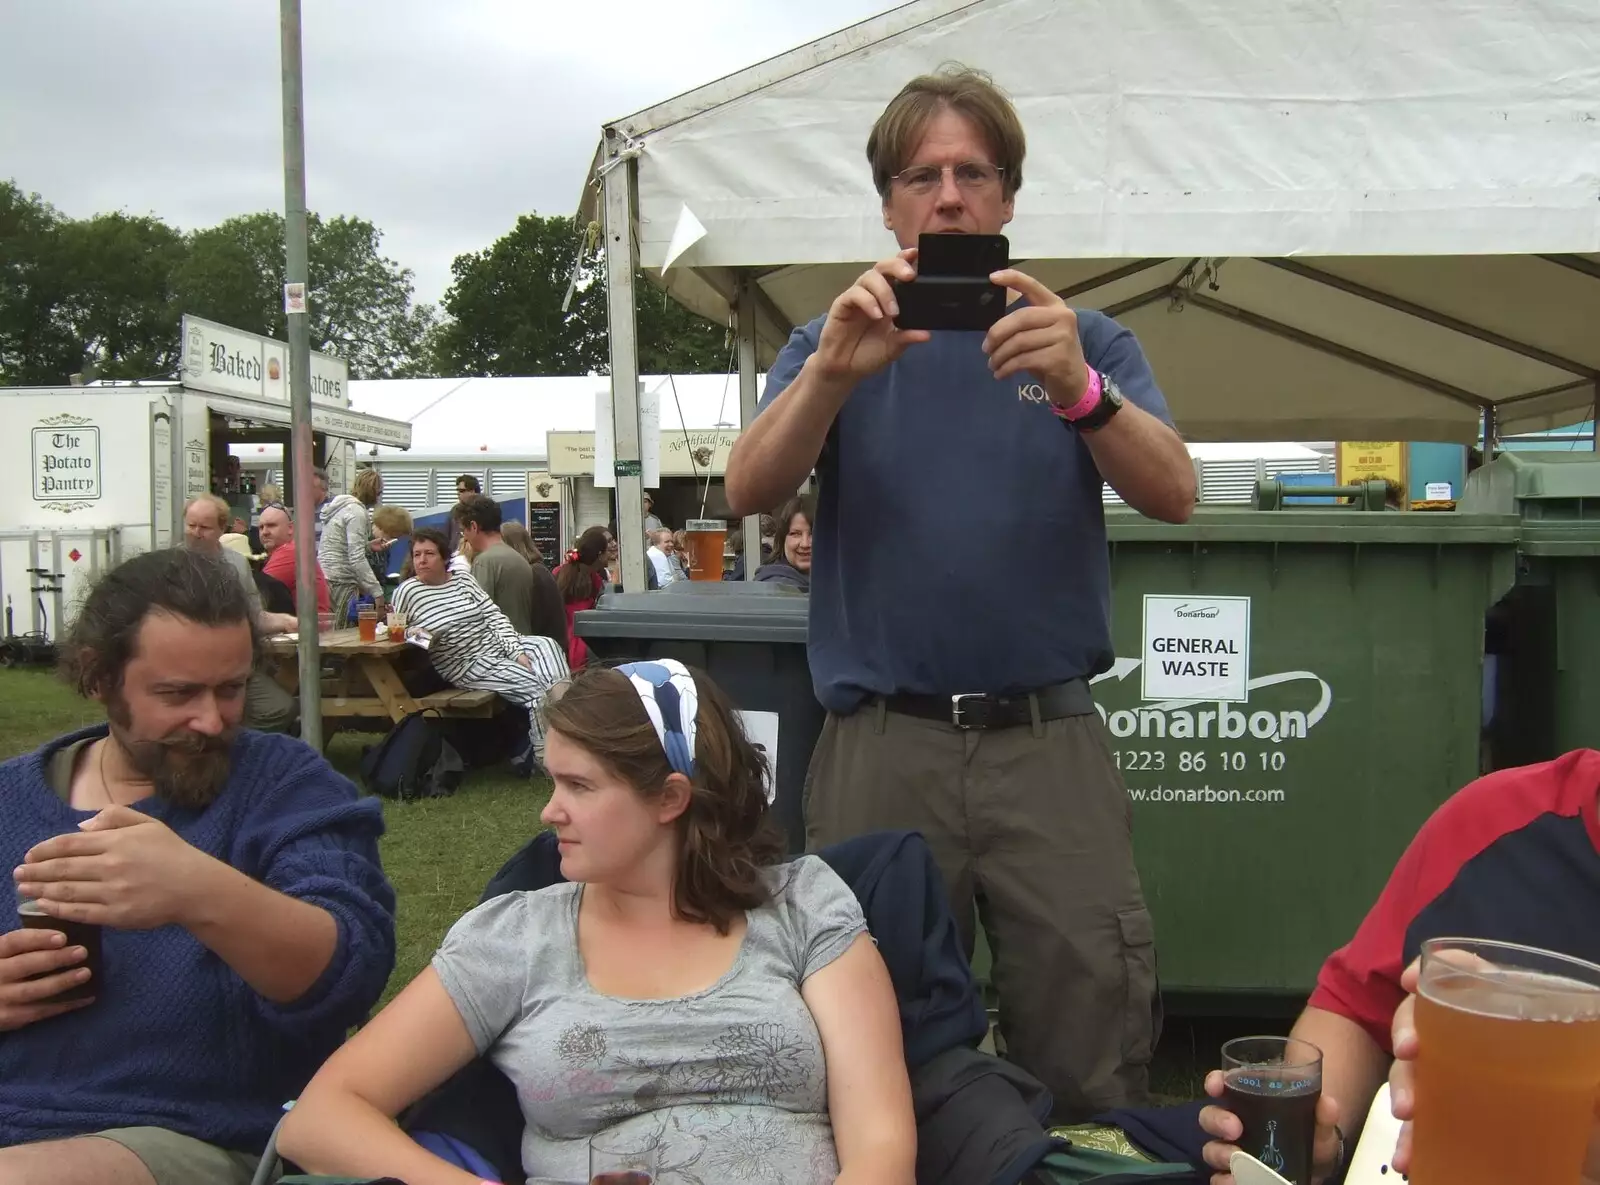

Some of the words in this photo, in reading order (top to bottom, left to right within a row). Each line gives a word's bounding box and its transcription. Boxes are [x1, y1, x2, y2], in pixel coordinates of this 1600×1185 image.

[209, 341, 261, 382] Baked
[52, 433, 81, 450] The
[669, 433, 716, 452] Northfield
[718, 436, 735, 447] Far
[41, 455, 92, 472] Potato
[41, 475, 94, 494] Pantry
[1177, 610, 1216, 619] Donarbon
[1152, 637, 1239, 655] GENERAL
[1162, 660, 1229, 677] WASTE
[1178, 751, 1207, 772] 86
[1220, 751, 1247, 771] 10
[1259, 751, 1286, 771] 10
[1127, 784, 1285, 802] w.donarbon.com
[1268, 1081, 1283, 1089] as
